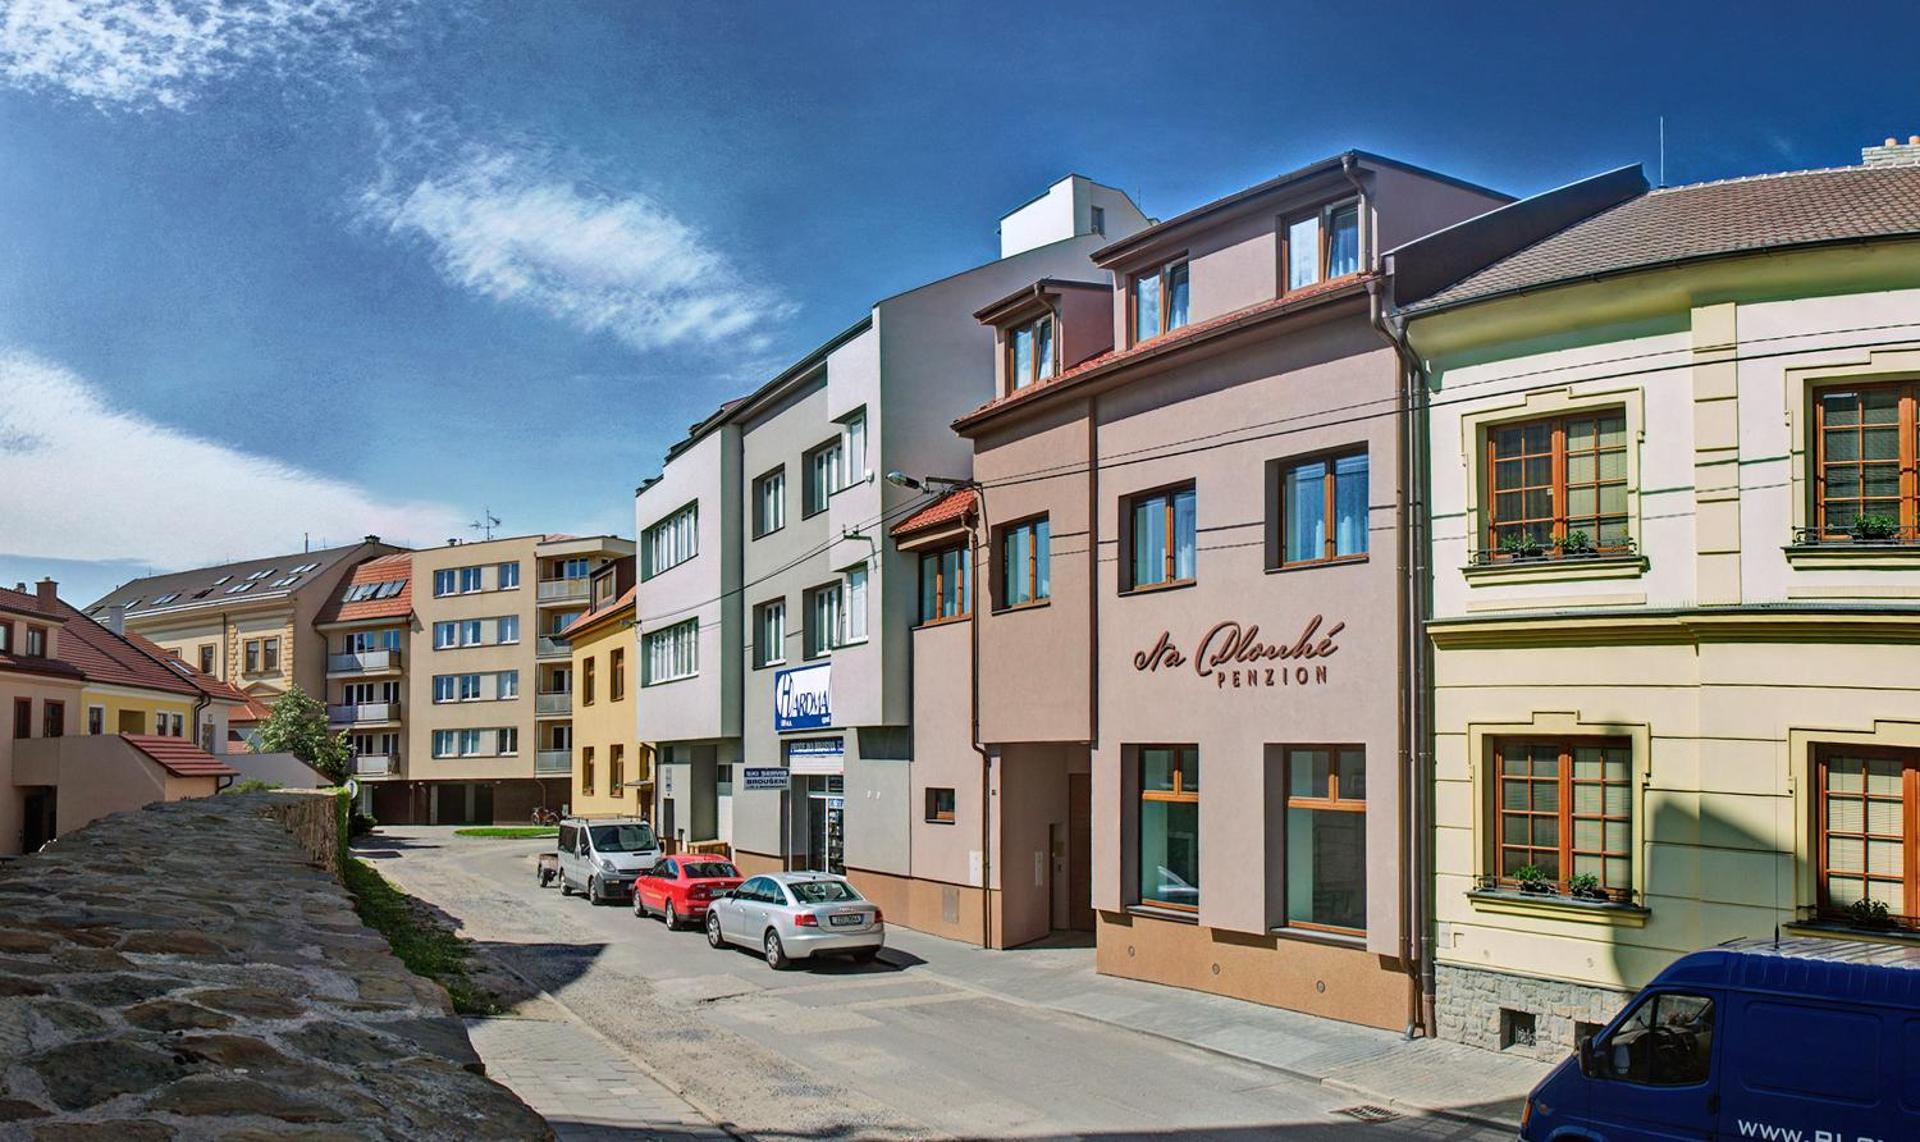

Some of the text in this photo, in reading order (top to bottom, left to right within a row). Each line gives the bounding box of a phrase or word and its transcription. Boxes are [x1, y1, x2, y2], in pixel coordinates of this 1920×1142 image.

[1134, 614, 1345, 677] Na Dlouhé
[1217, 665, 1327, 688] PENZION
